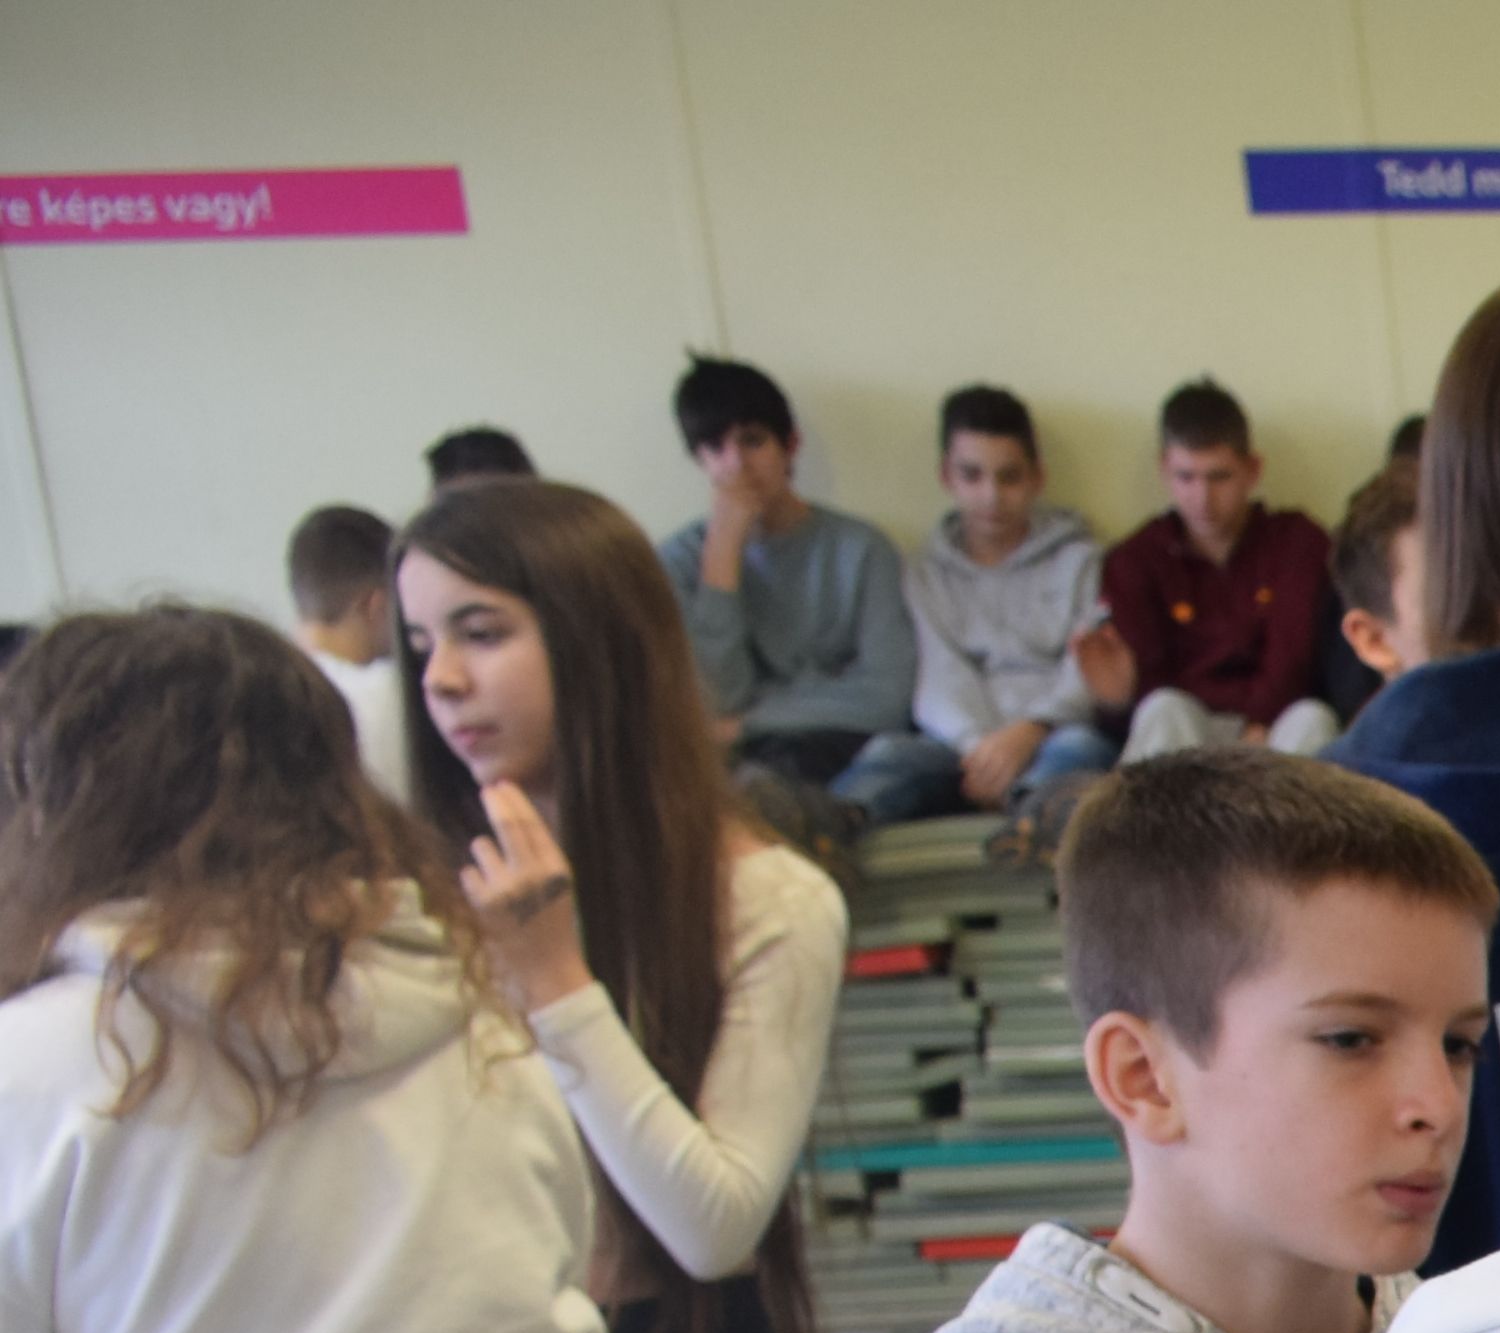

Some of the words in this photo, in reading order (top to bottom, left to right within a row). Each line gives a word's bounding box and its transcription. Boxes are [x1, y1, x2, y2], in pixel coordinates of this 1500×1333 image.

[1376, 158, 1467, 199] Tedd
[38, 187, 157, 232] képes
[163, 183, 272, 232] vagy!
